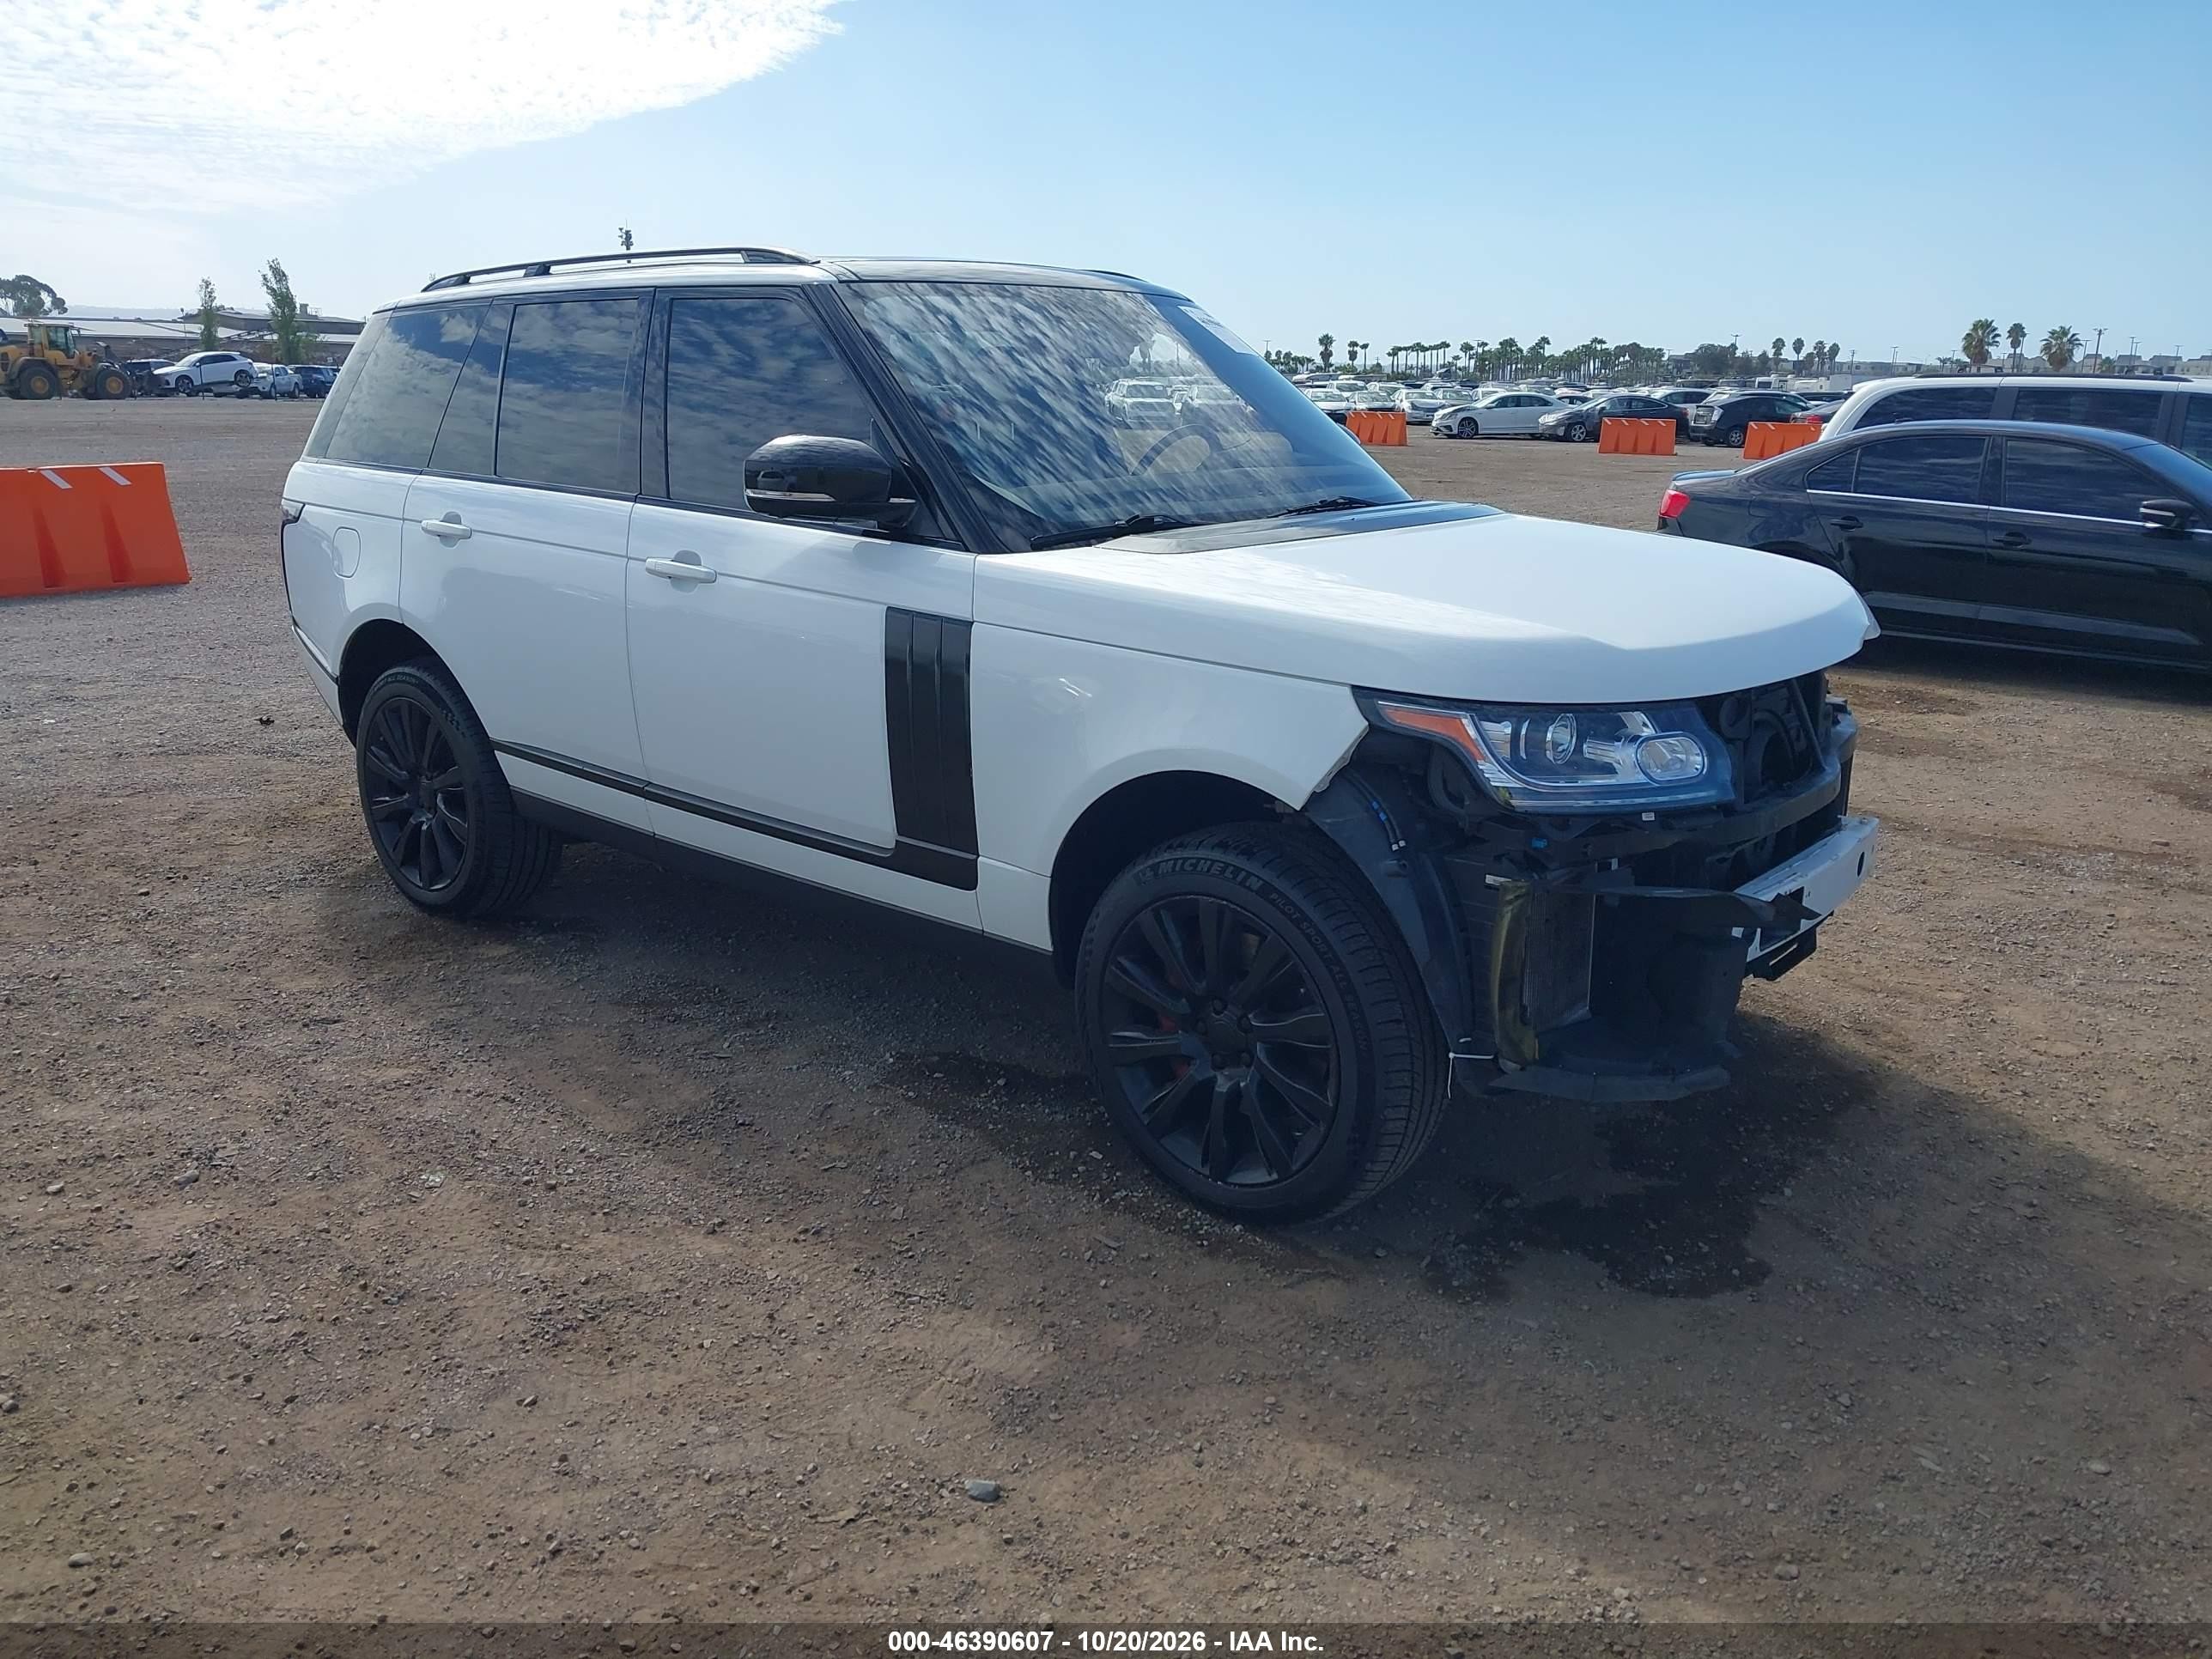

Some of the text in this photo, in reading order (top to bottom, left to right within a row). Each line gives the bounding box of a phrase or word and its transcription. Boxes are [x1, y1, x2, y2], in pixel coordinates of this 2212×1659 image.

[1158, 858, 1265, 891] MICHELIN
[1269, 892, 1301, 921] PILOT
[1299, 921, 1334, 964] SPORT
